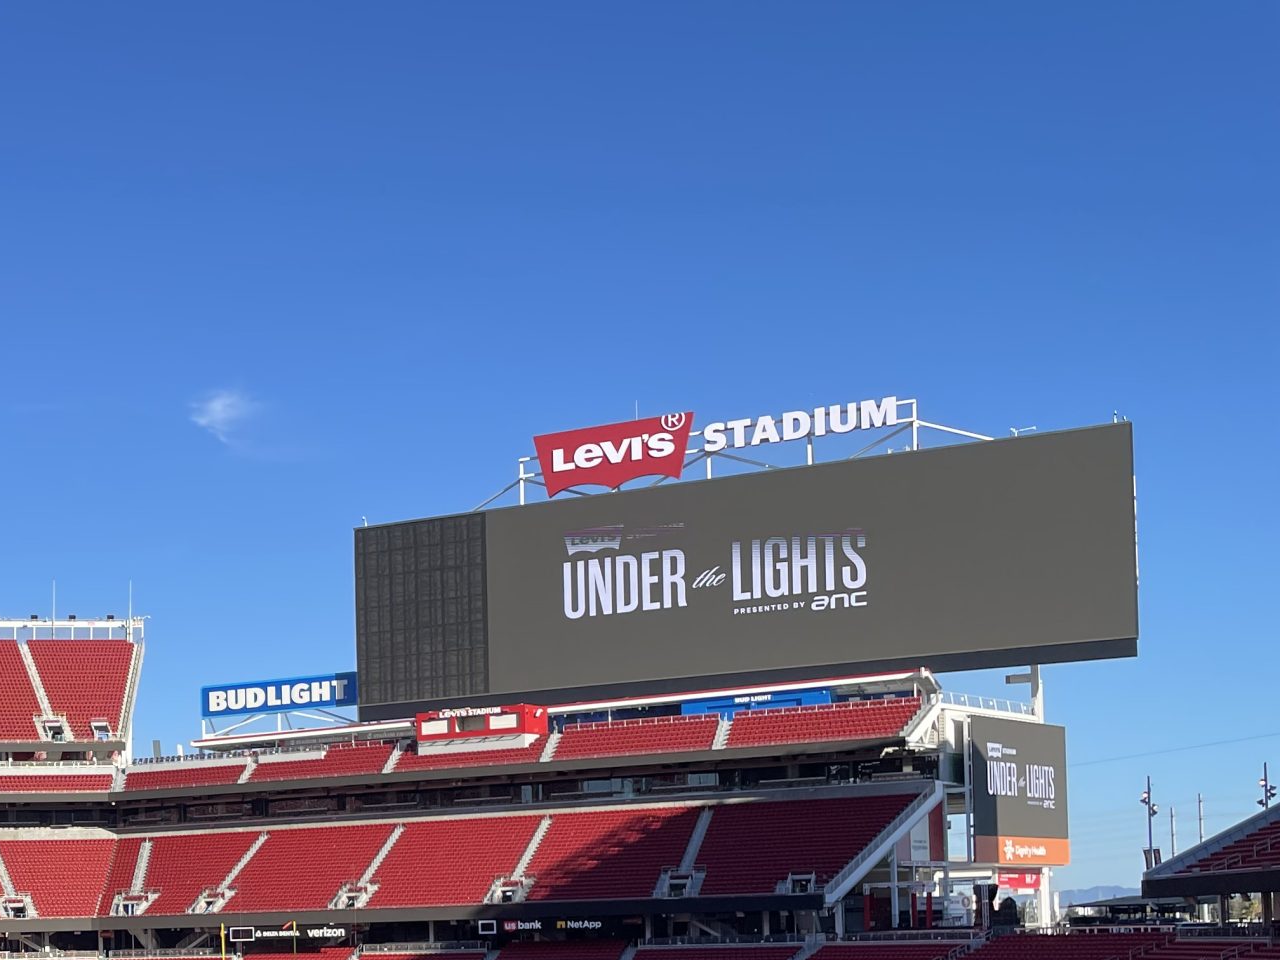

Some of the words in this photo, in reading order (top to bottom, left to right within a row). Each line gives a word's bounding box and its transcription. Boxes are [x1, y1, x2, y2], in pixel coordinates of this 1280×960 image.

[704, 395, 898, 452] STADIUM
[563, 549, 687, 620] UNDER
[692, 566, 726, 589] the
[731, 535, 867, 601] LIGHTS
[733, 604, 790, 616] PRESENTED
[793, 601, 806, 610] BY
[208, 686, 265, 712] BUD
[266, 678, 348, 707] LIGHT
[986, 760, 1018, 797] UNDER
[1025, 764, 1055, 800] LIGHTS
[307, 926, 346, 938] verizon
[504, 921, 517, 931] us
[518, 919, 542, 930] bank
[567, 919, 602, 929] NetApp
